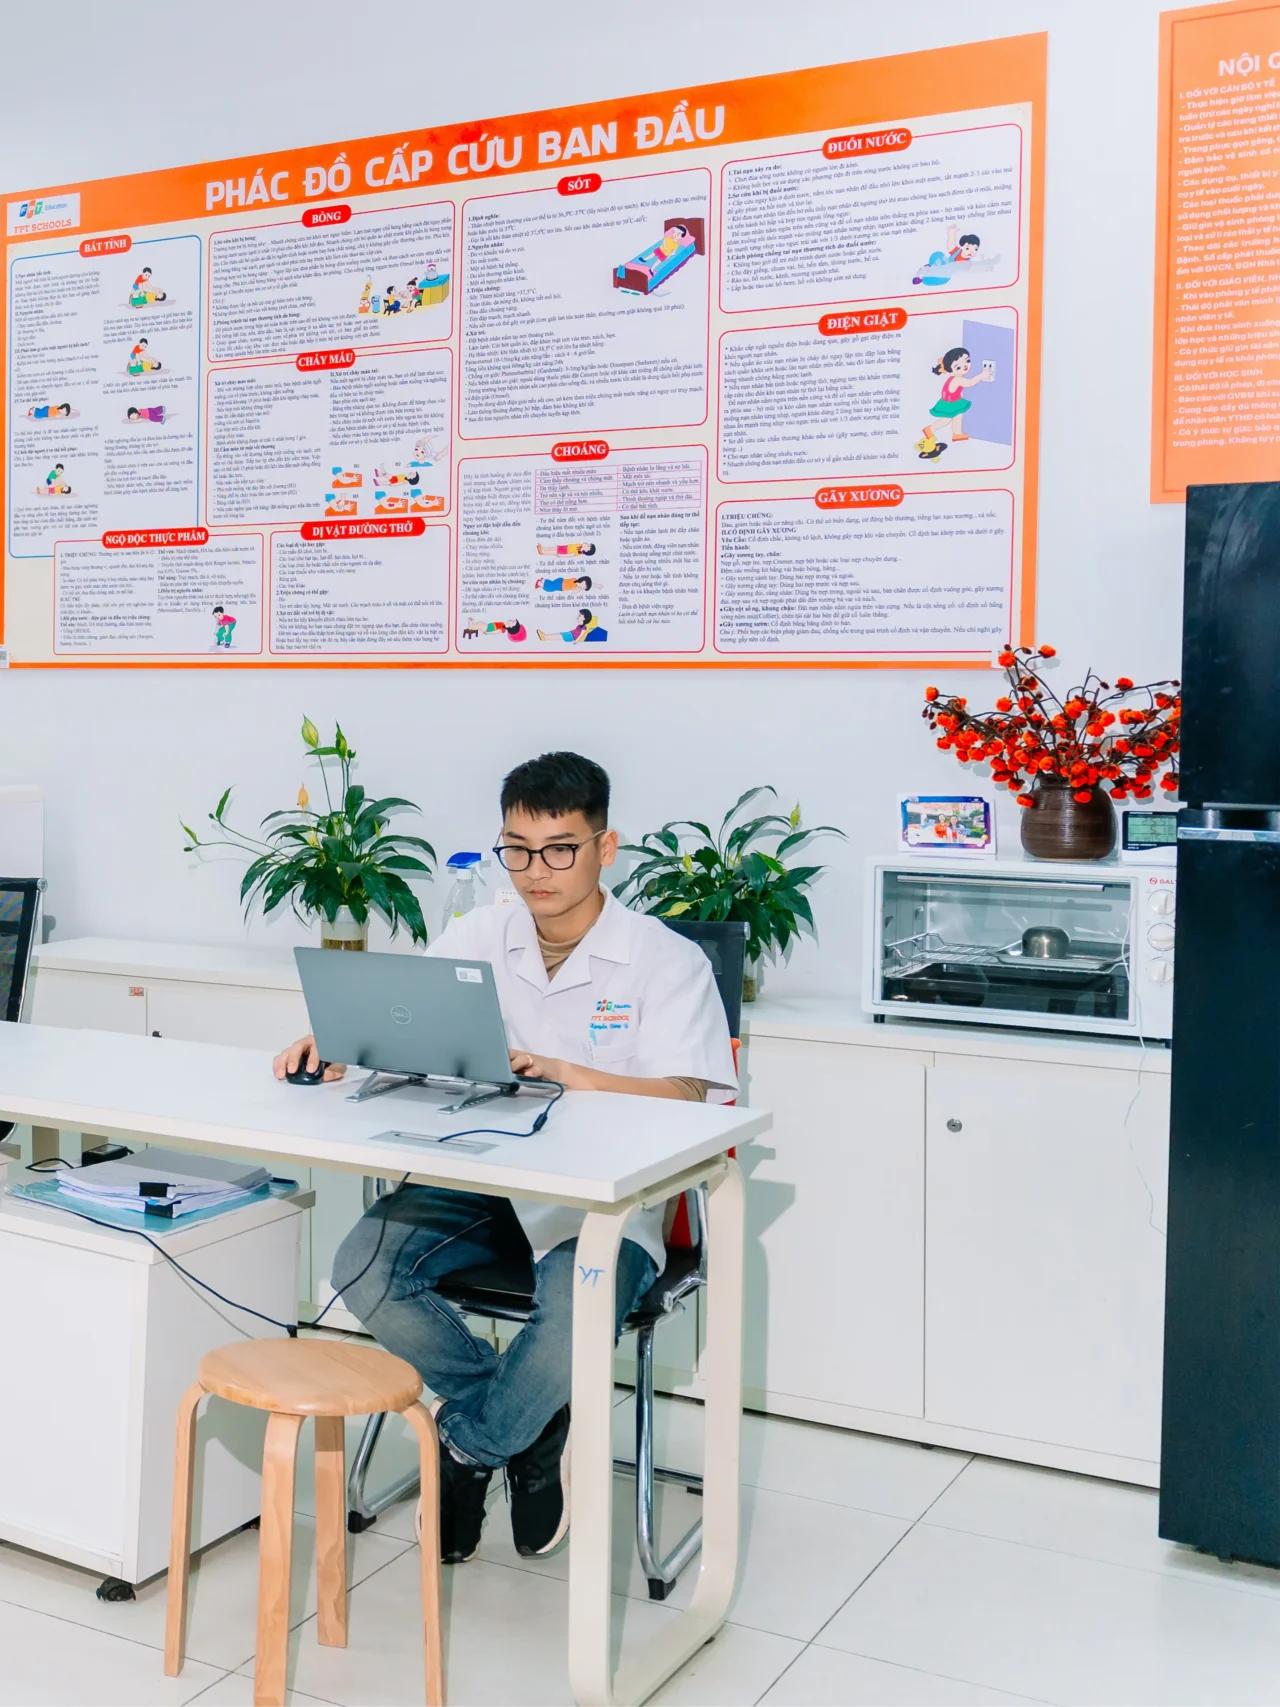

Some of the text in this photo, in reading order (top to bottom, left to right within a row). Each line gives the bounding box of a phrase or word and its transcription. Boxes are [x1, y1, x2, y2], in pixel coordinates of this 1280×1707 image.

[1219, 52, 1260, 77] NỘI
[1186, 88, 1202, 99] ĐỐI
[1204, 87, 1219, 96] VỚI
[1220, 84, 1240, 94] CÁN
[1241, 81, 1255, 92] BỘ
[1264, 77, 1275, 87] TẾ
[828, 132, 907, 153] ĐUỐI NƯỚC
[205, 100, 725, 210] PHÁC ĐỒ CẤP CỨU BAN ĐẦU
[568, 177, 592, 191] SỐT
[45, 203, 68, 211] Education
[14, 218, 72, 234] FPT SCHOOLS
[1185, 277, 1201, 289] ĐỐI
[1202, 276, 1218, 286] VỚI
[1219, 274, 1241, 285] GIÁO
[1242, 273, 1265, 282] VIÊN,
[827, 313, 898, 331] ĐIỆN GIẬT
[298, 351, 354, 367] CHẢY MÁU
[1186, 370, 1201, 380] ĐỐI
[1203, 371, 1218, 380] VỚI
[1220, 370, 1239, 379] HỌC
[1241, 368, 1263, 377] SINH
[554, 442, 606, 457] CHOÁNG
[818, 489, 900, 504] GÃY XƯƠNG
[312, 520, 413, 538] DỊ VẬT ĐƯỜNG THỞ
[105, 529, 206, 546] NGỘ ĐỘC THỰC PHẨM
[578, 1265, 606, 1289] YT
